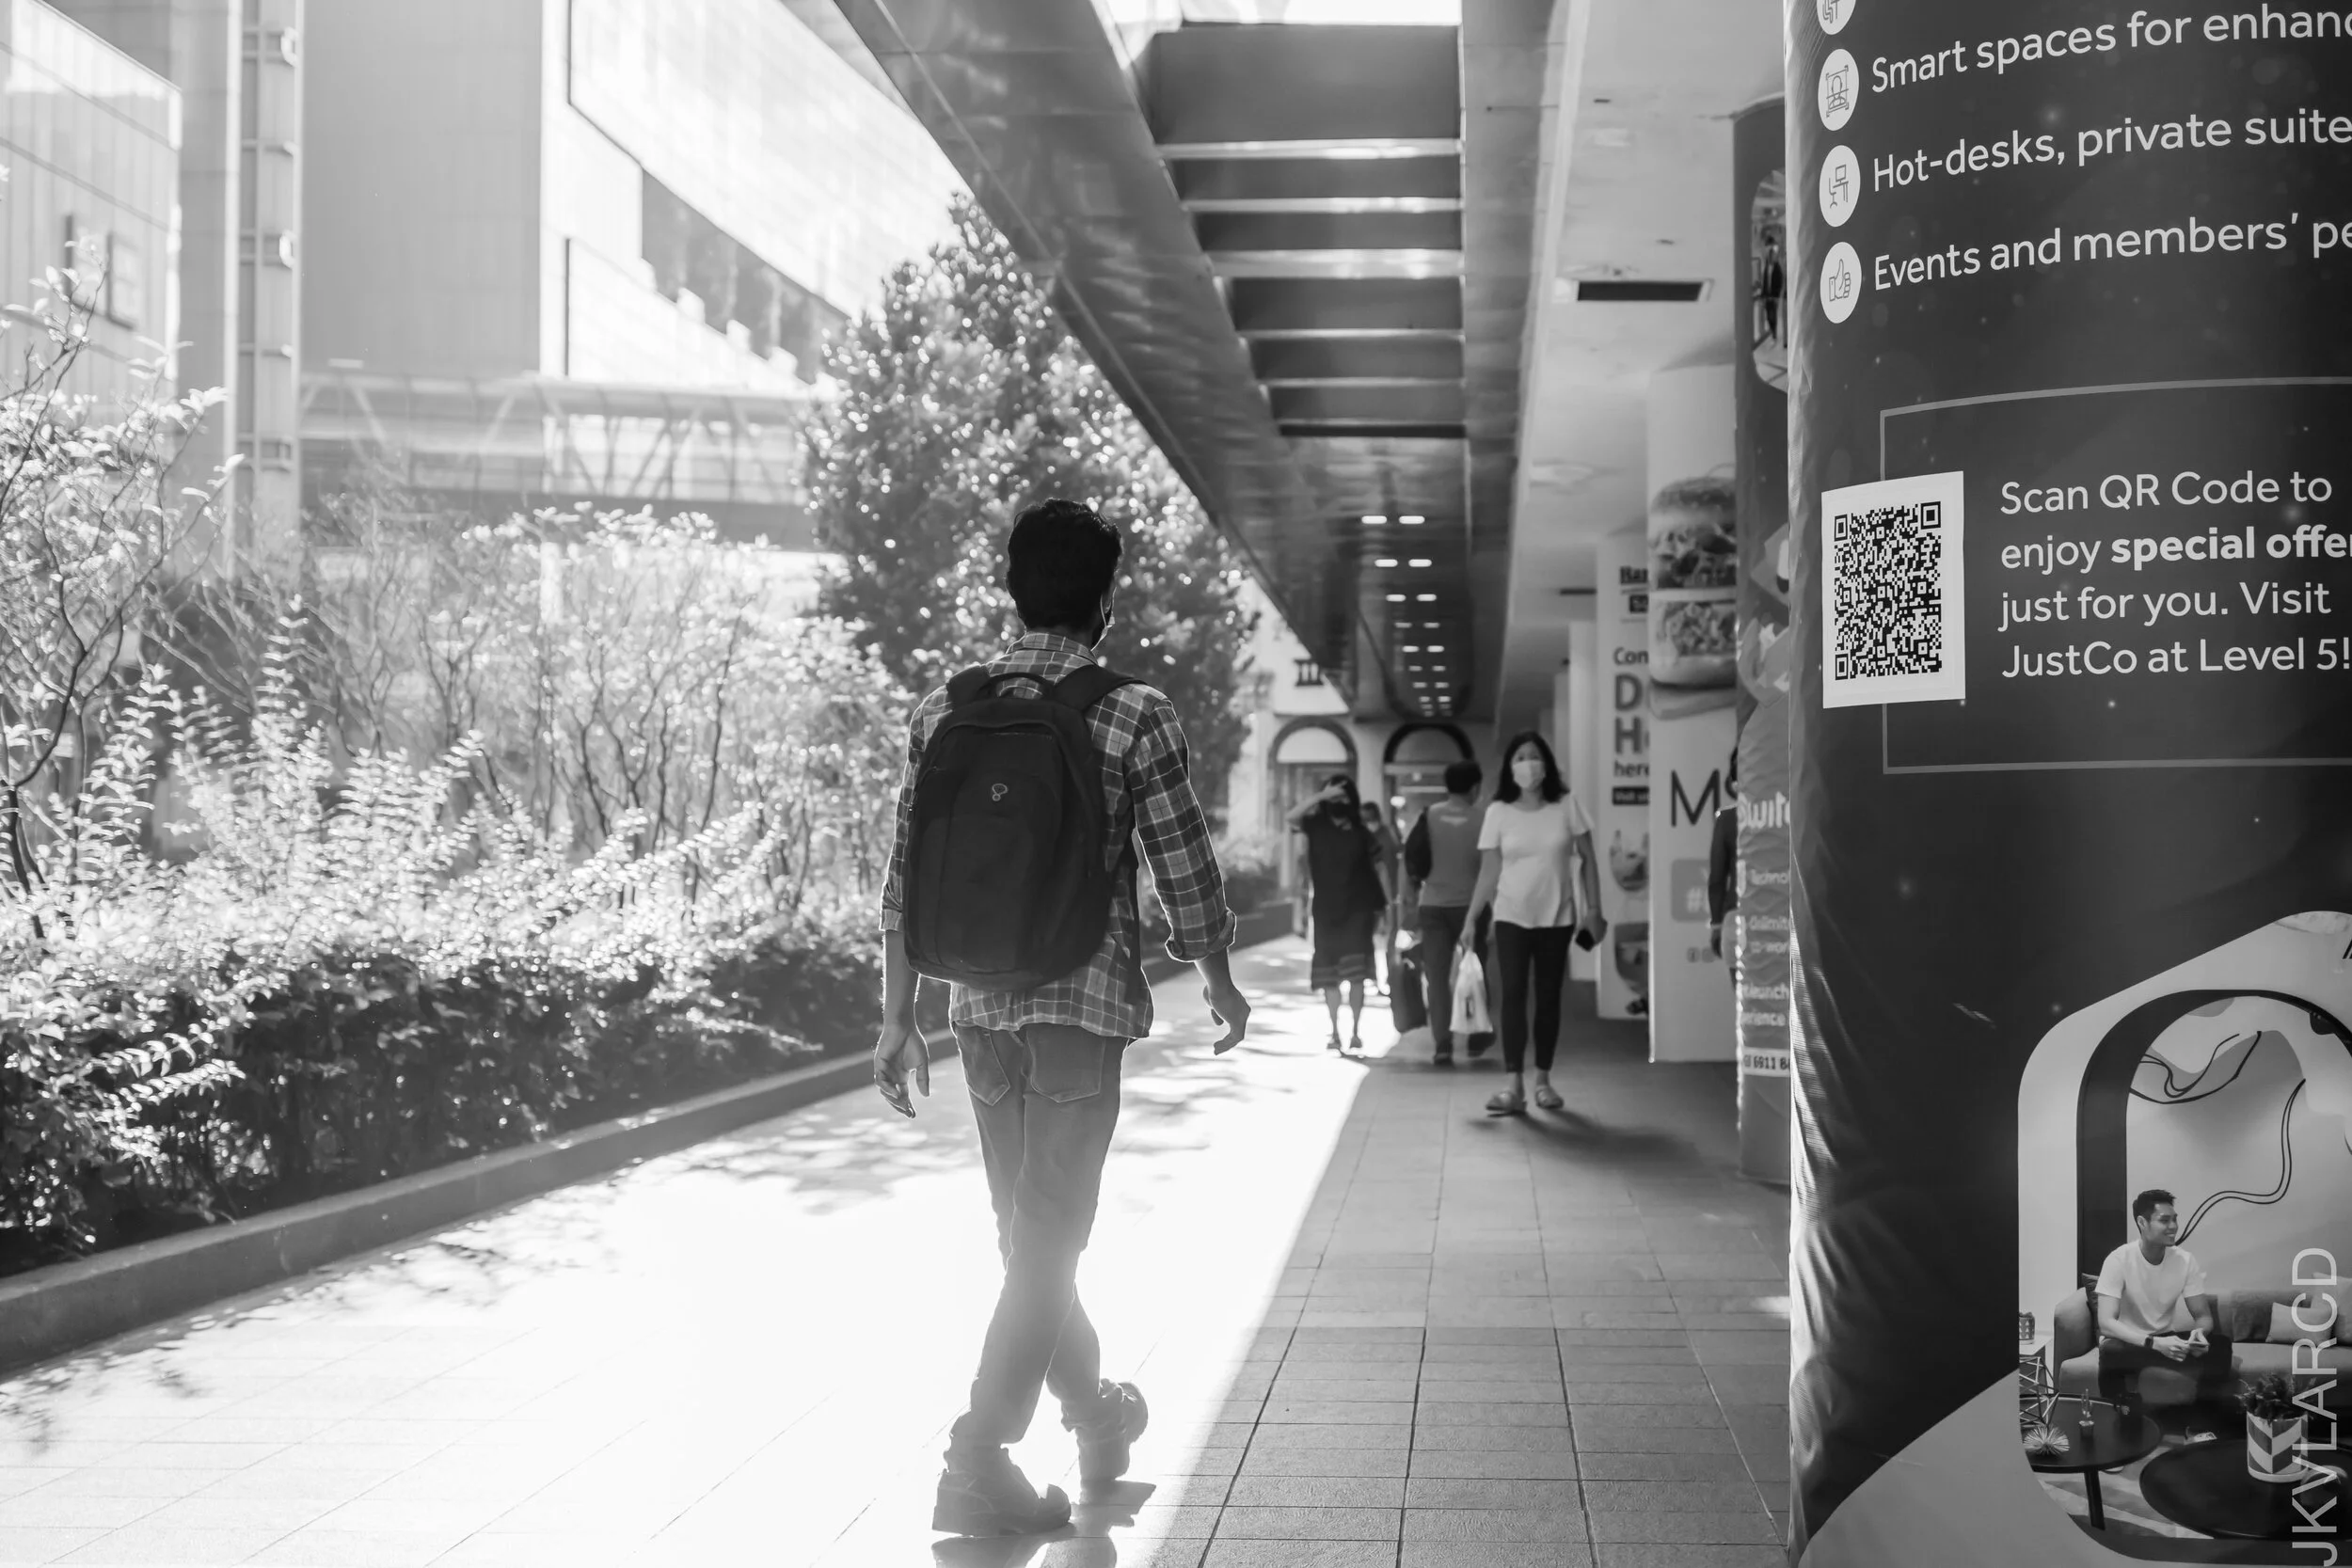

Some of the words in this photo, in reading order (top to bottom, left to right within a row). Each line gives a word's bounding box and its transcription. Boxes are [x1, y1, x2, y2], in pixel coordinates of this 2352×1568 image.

[1871, 40, 1968, 93] Smart
[1976, 24, 2117, 75] spaces
[2126, 9, 2192, 48] for
[1873, 129, 2066, 192] Hot-desks,
[2077, 114, 2233, 167] private
[2244, 107, 2352, 146] suite
[1874, 244, 1981, 291] Events
[1990, 227, 2061, 271] and
[2000, 481, 2089, 515] Scan
[2099, 473, 2161, 511] QR
[2171, 469, 2280, 507] Code
[2289, 471, 2332, 502] to
[2001, 534, 2102, 576] enjoy
[2110, 526, 2255, 572] special
[2265, 524, 2352, 559] offe
[1996, 590, 2070, 633] just
[2076, 586, 2135, 620] for
[2142, 592, 2229, 627] you.
[2239, 581, 2332, 615] Visit
[2001, 641, 2137, 678] JustCo
[2147, 641, 2189, 673] at
[2200, 637, 2305, 672] Level
[2316, 636, 2350, 671] 5!
[1615, 717, 1649, 754] H
